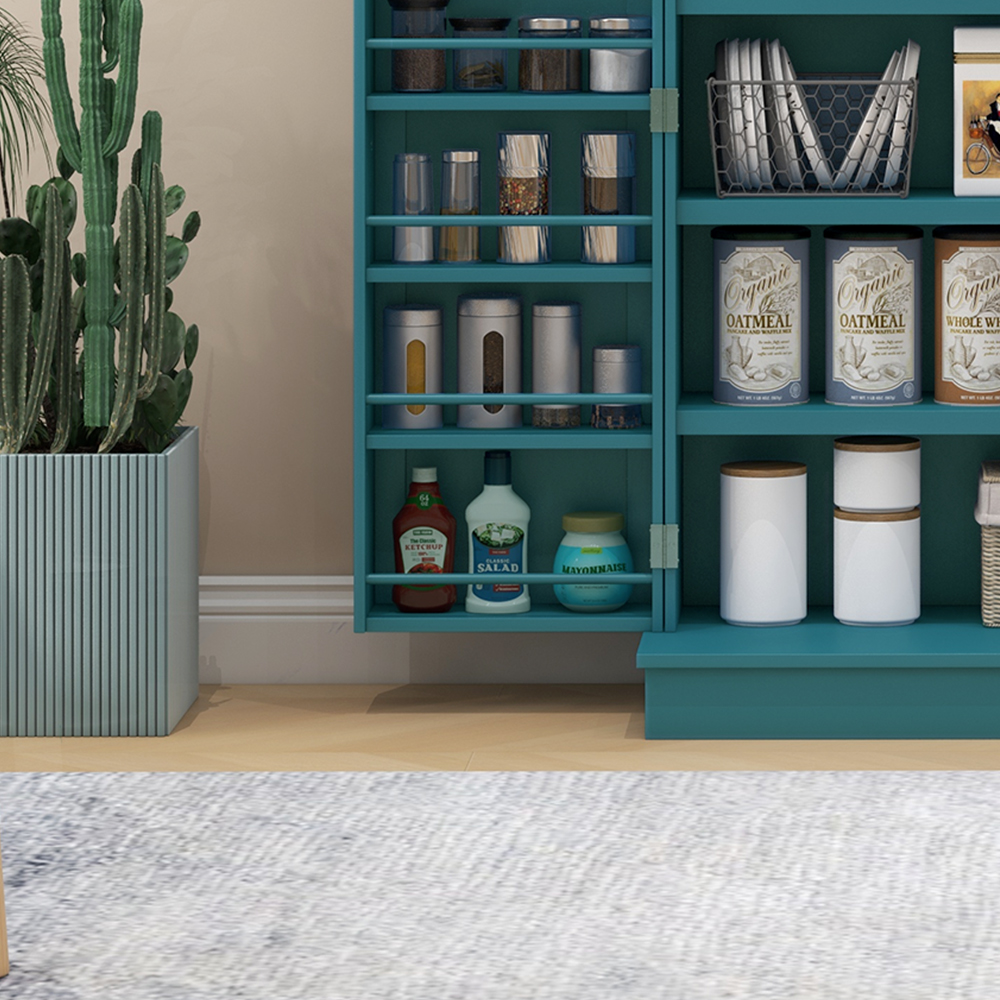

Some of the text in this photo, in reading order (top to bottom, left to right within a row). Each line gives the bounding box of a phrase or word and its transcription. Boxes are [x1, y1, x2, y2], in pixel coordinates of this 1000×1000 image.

[724, 264, 791, 312] Organic
[838, 264, 905, 312] Organic
[726, 313, 792, 328] OATMEAL
[840, 313, 906, 328] OATMEAL
[946, 316, 983, 328] WHOLE
[477, 564, 519, 573] SALAD
[562, 563, 626, 574] MAYONNAISE
